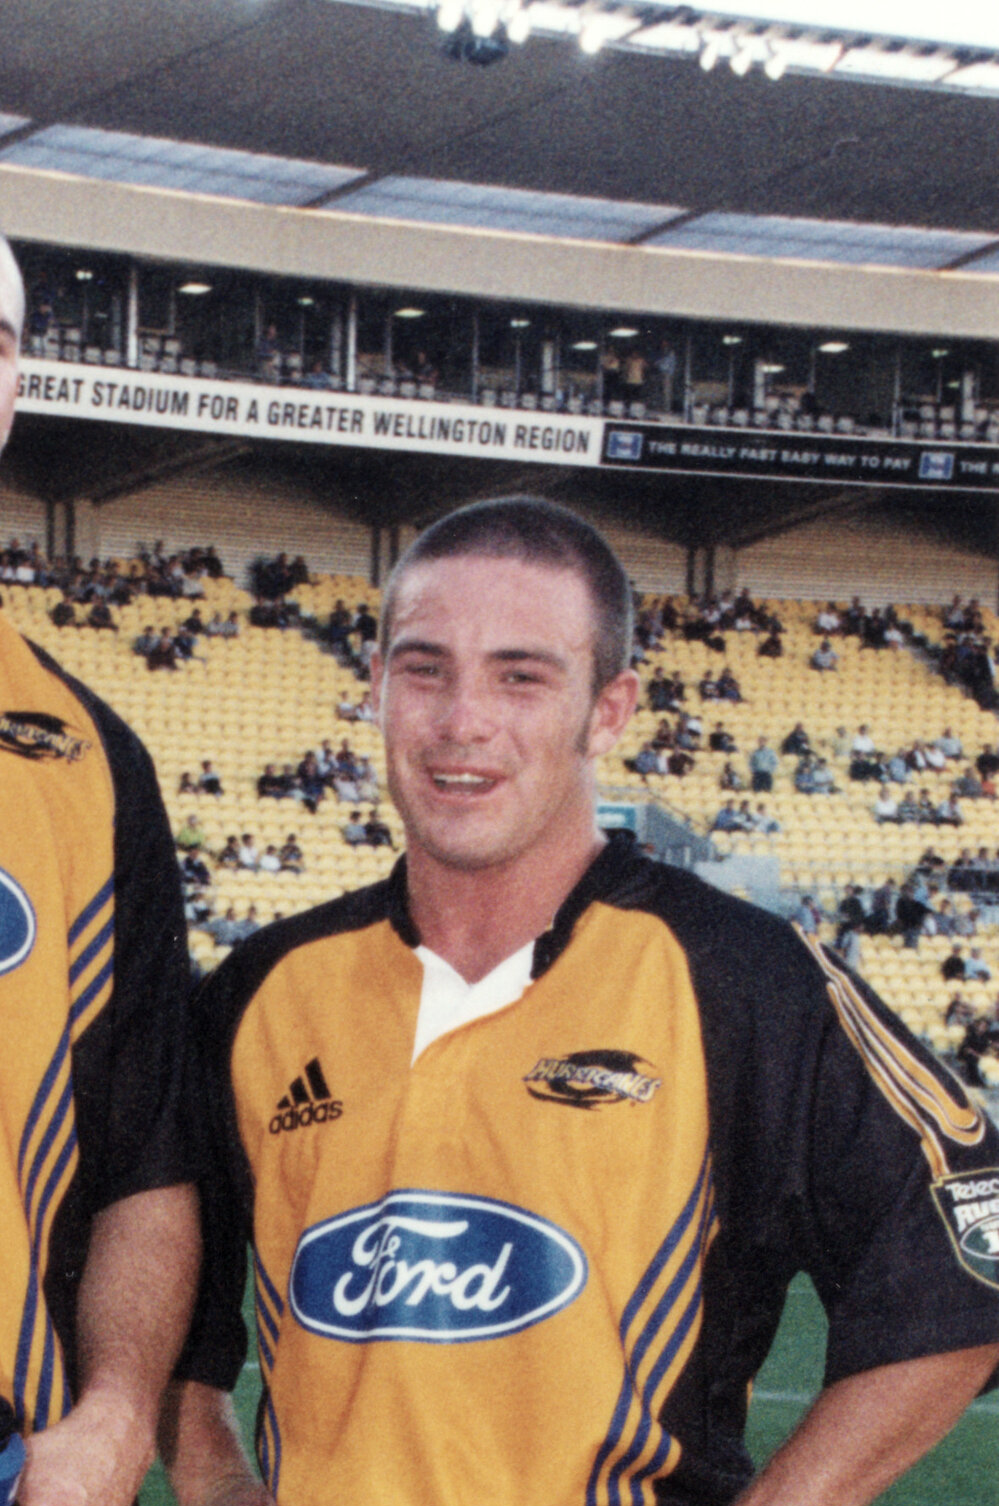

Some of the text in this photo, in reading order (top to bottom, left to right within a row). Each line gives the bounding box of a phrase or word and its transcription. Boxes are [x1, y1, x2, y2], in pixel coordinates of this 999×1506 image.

[16, 373, 83, 404] GREAT
[92, 382, 189, 417] STADIUM
[198, 394, 238, 421] FOR
[246, 400, 258, 423] A
[267, 401, 364, 433] GREATER
[373, 412, 506, 446] WELLINGTON
[513, 425, 590, 453] REGION
[648, 441, 676, 455] THE
[680, 443, 735, 459] REALLY
[740, 448, 777, 461] FAST
[781, 450, 820, 464] EASY
[824, 453, 856, 466] WAY
[861, 455, 880, 468] TO
[884, 457, 911, 470] PAY
[960, 461, 988, 474] THE
[522, 1058, 661, 1103] HURRICANES
[268, 1100, 343, 1134] adidas
[333, 1216, 513, 1316] Ford
